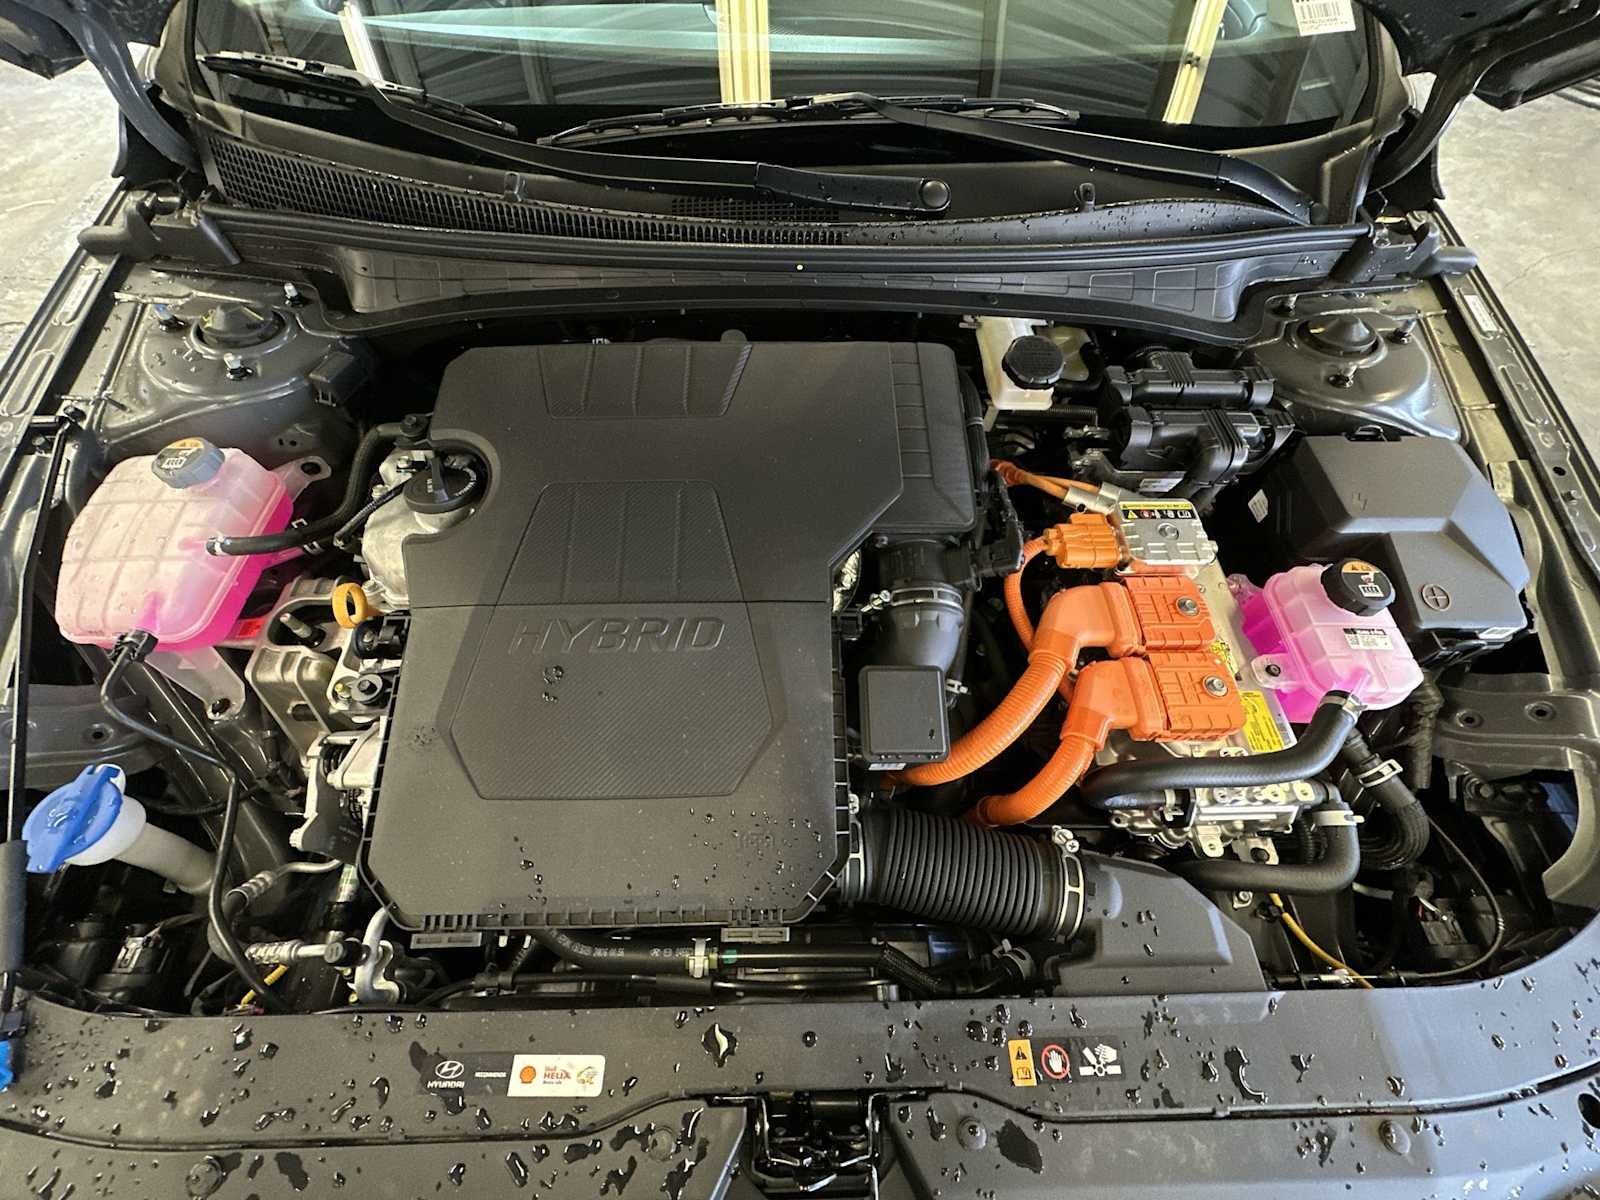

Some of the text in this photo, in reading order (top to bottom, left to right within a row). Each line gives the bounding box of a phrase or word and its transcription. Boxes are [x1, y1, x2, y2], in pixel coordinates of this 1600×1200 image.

[507, 616, 727, 655] HYBRID
[543, 1070, 572, 1080] HELIX
[427, 1081, 465, 1089] HYUNDAI
